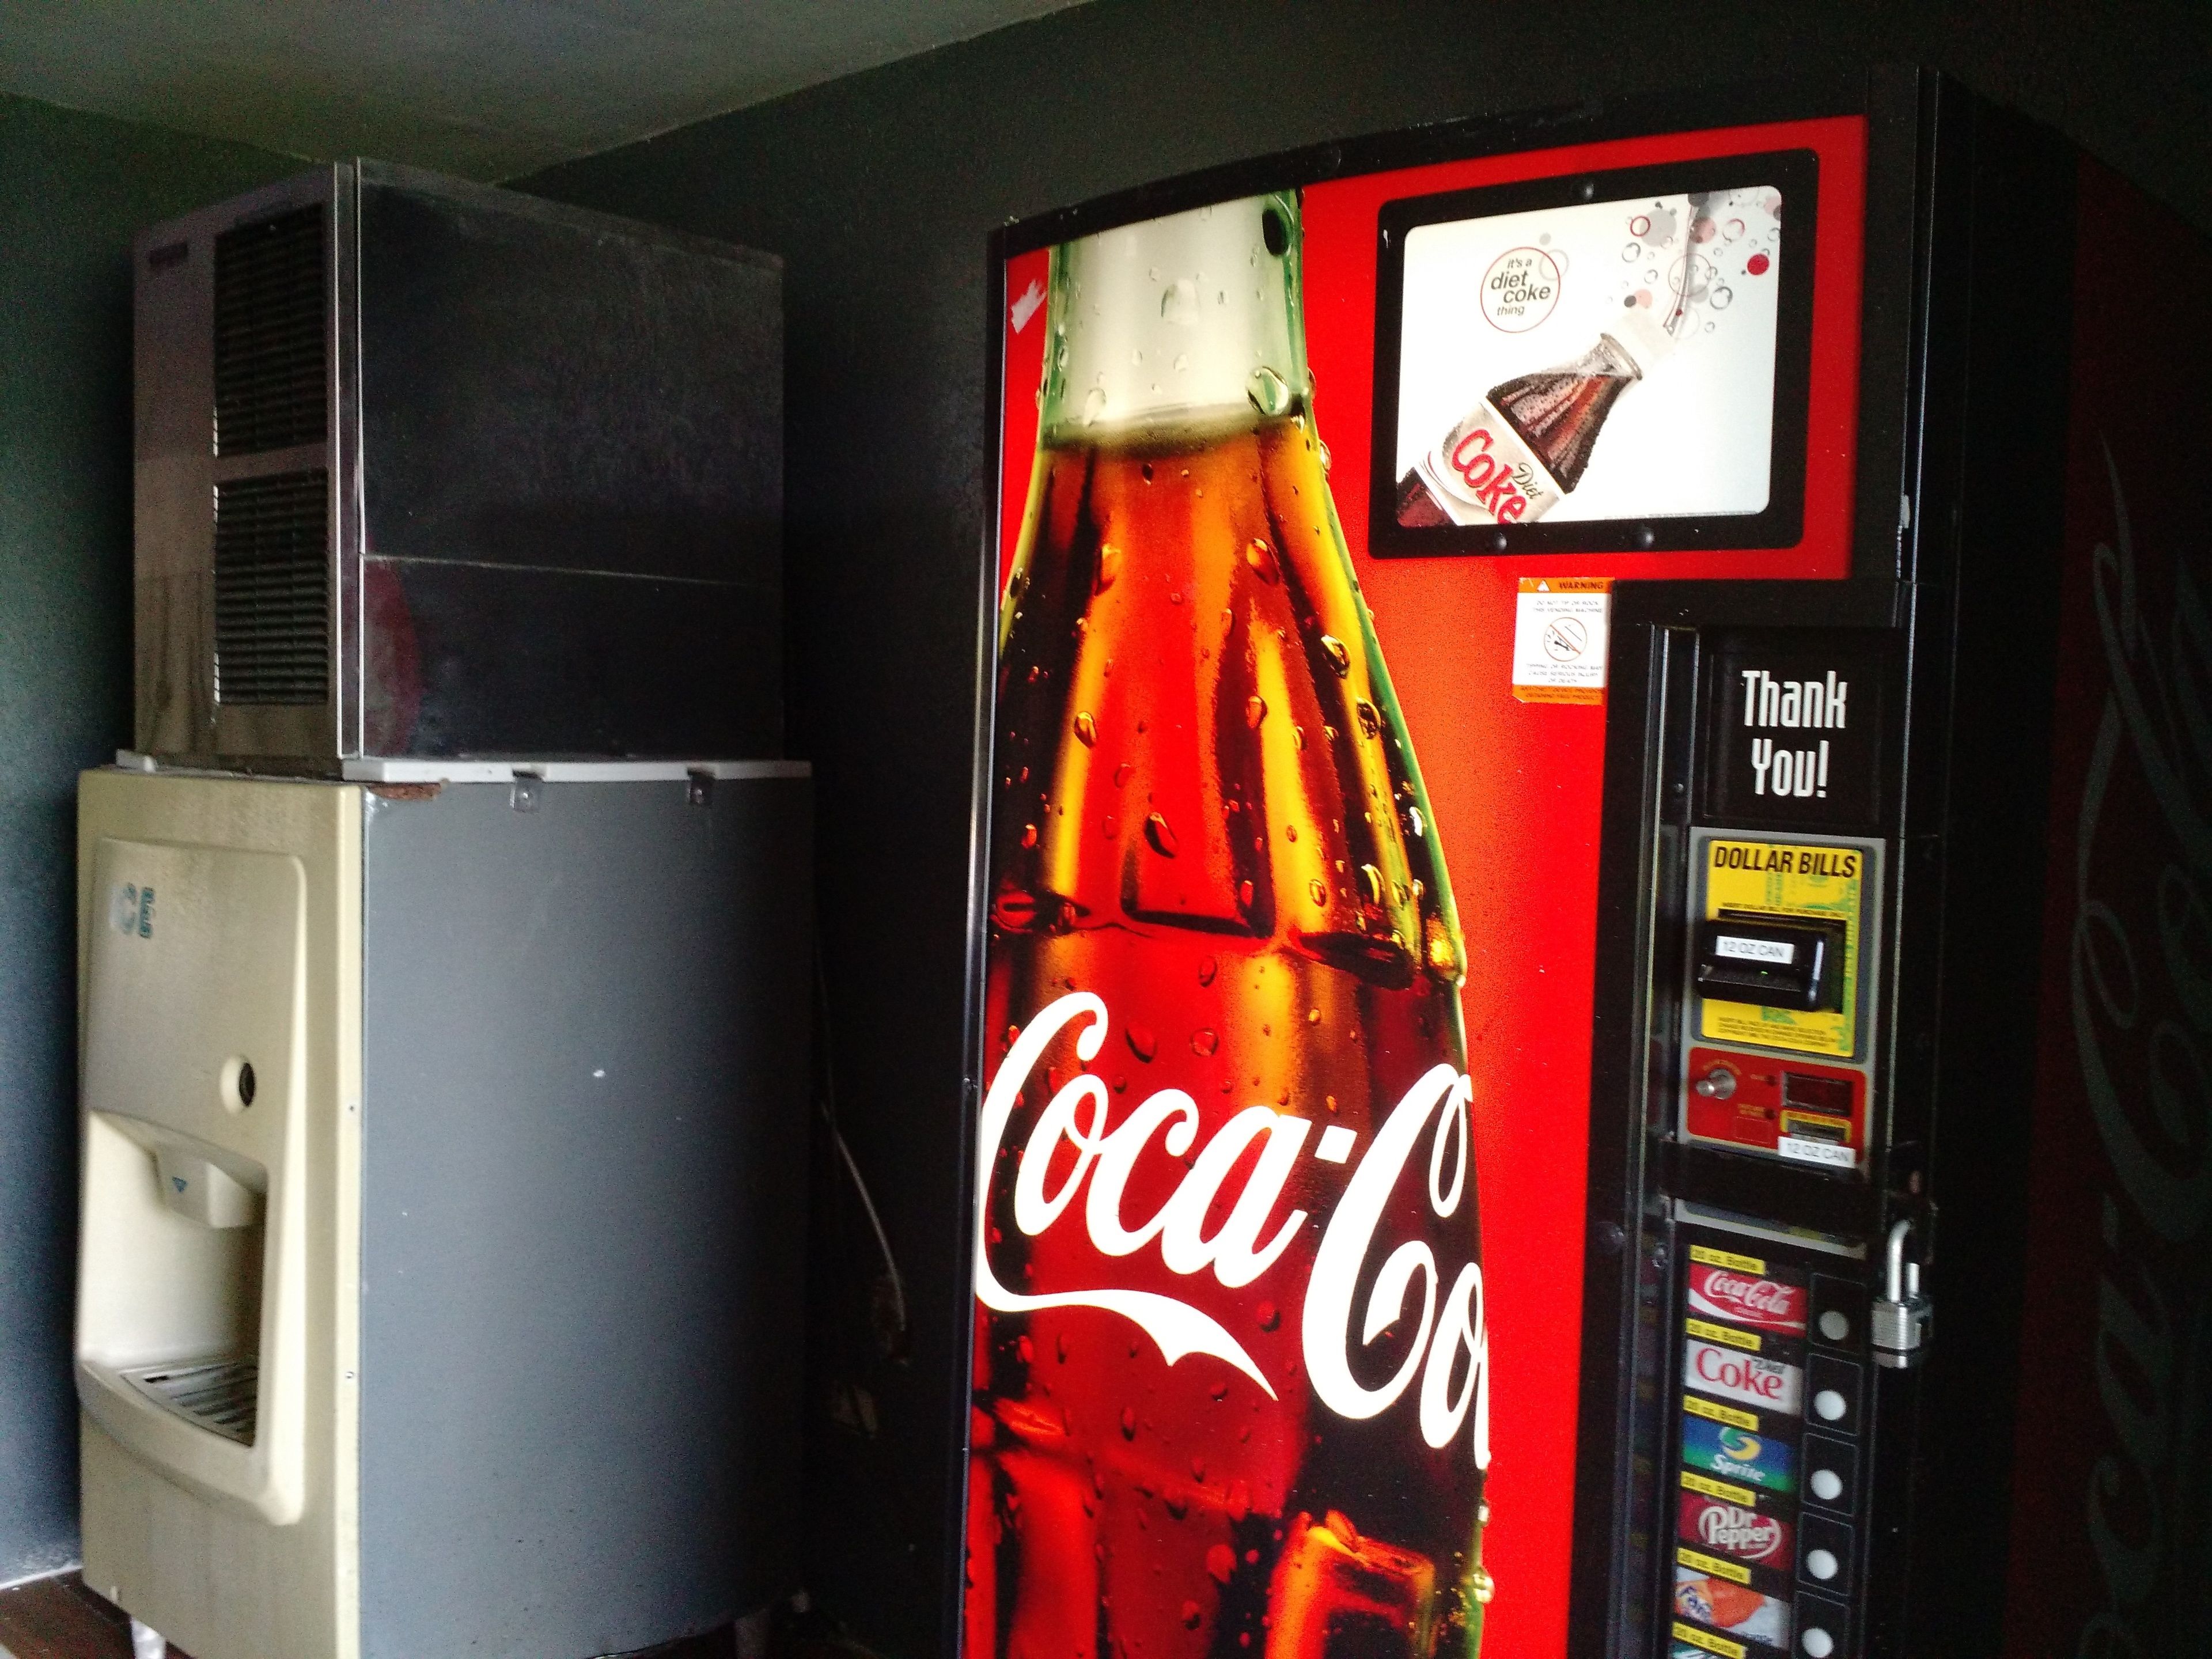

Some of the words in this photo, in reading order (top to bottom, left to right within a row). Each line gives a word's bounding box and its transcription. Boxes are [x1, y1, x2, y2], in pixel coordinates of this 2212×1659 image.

[1508, 258, 1522, 268] it's
[1525, 259, 1532, 267] a
[1491, 270, 1528, 290] diet
[1503, 283, 1551, 303] coke
[1497, 305, 1525, 316] thing
[1452, 429, 1527, 524] Coke
[1512, 462, 1544, 499] Diet
[1559, 580, 1604, 590] WARNING
[1741, 670, 1848, 728] Thank
[1751, 738, 1830, 798] You!
[1714, 846, 1793, 873] DOLLAR
[1798, 854, 1856, 877] BILLS
[1722, 940, 1736, 953] 12
[1738, 941, 1756, 956] OZ
[1758, 944, 1785, 958] CAN
[1787, 1143, 1800, 1154] 12
[1823, 1148, 1849, 1162] CAN
[1704, 1270, 1796, 1315] Coca-Cola
[1695, 1347, 1784, 1400] Coke
[1710, 1454, 1766, 1482] Sprite
[1707, 1506, 1772, 1550] Pepper
[1728, 1506, 1758, 1525] Dr
